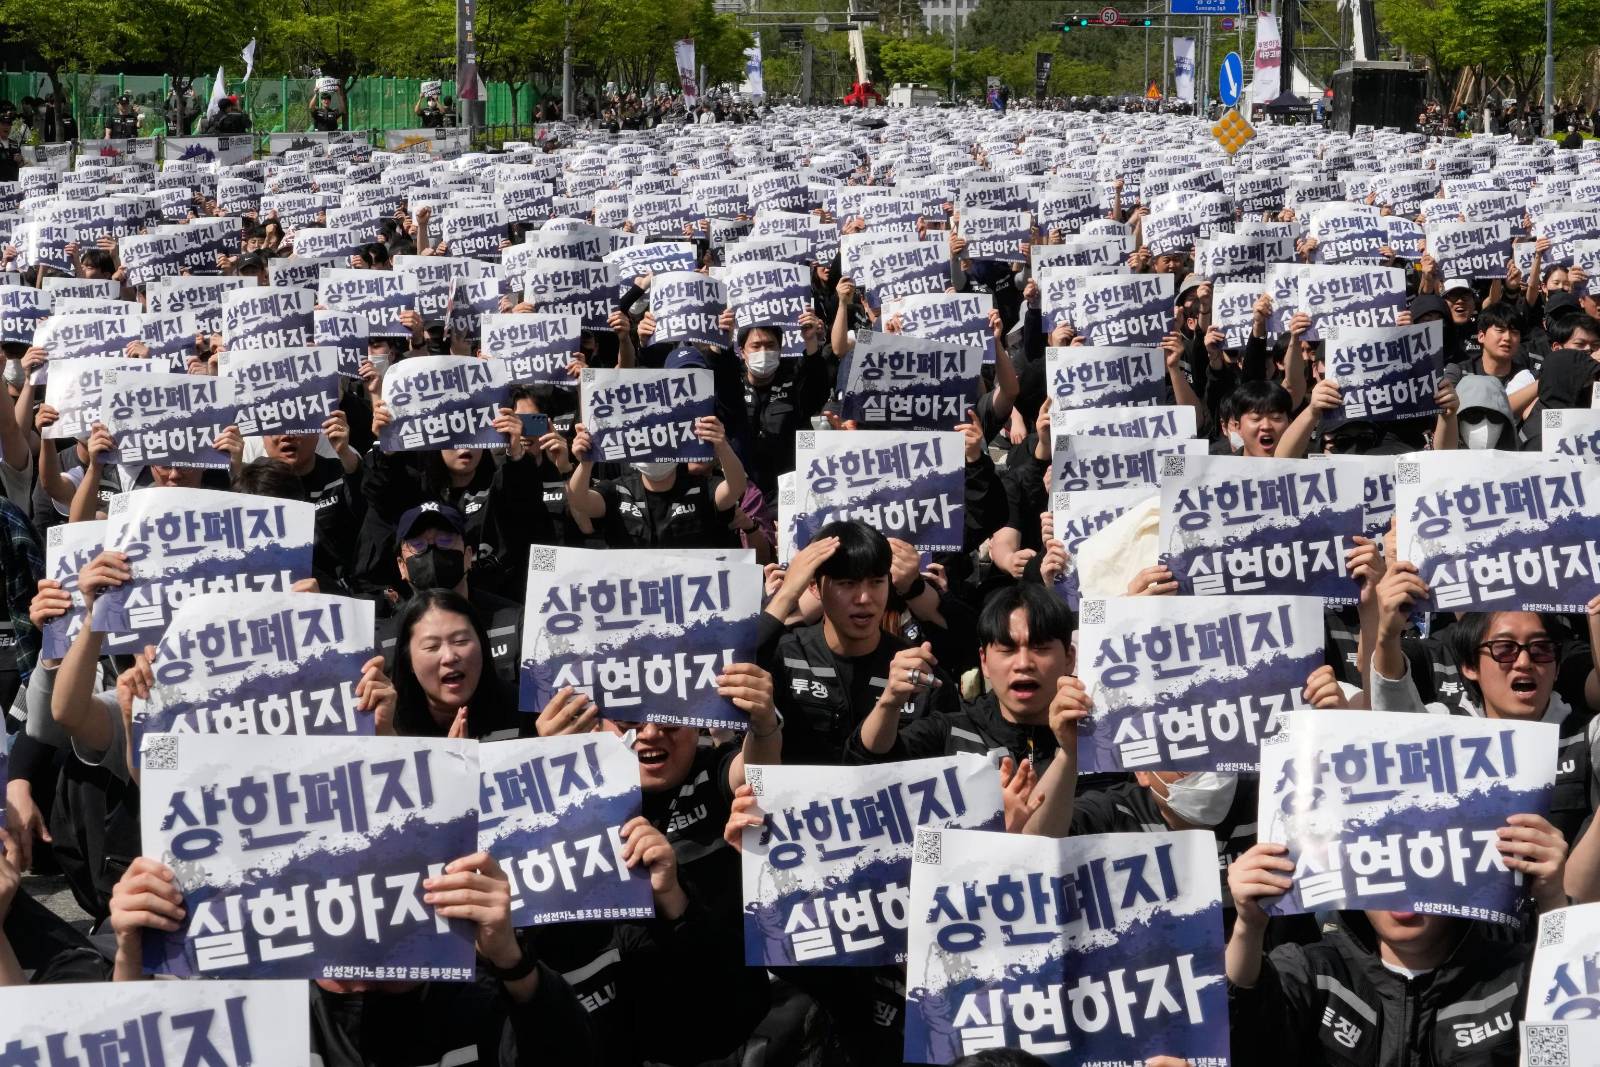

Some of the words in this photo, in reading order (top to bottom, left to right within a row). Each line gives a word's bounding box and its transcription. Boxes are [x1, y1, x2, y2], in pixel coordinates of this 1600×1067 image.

[1104, 11, 1115, 22] 50
[502, 186, 546, 204] 상한폐지
[965, 185, 1019, 207] 상한폐지
[1042, 194, 1091, 216] 상한폐지
[1466, 195, 1518, 216] 상한폐지
[713, 225, 753, 242] 상한폐
[964, 215, 1021, 235] 상한폐지
[1435, 225, 1500, 252] 상한폐지
[123, 237, 177, 264] 상한폐지
[870, 245, 939, 278] 상한폐지
[1212, 241, 1282, 266] 상한폐지
[1442, 251, 1511, 279] 실현하자
[326, 275, 403, 304] 상한폐지
[415, 262, 469, 285] 한폐지
[532, 267, 610, 294] 상한폐지
[728, 267, 800, 297] 상한폐지
[1306, 271, 1394, 306] 상한폐지
[226, 291, 300, 330] 상한폐지
[651, 279, 720, 310] 상한폐지
[735, 295, 805, 326] 실현하자
[1082, 277, 1161, 315] 상한폐지
[487, 317, 568, 351] 상한폐지
[1090, 311, 1175, 347] 실현하자
[860, 349, 966, 380] 상한폐지
[1332, 327, 1432, 376] 상한폐지
[389, 361, 492, 406] 상한폐지
[1054, 353, 1153, 397] 상한폐지
[110, 381, 217, 419] 상한폐지
[589, 373, 697, 418] 상한폐지
[862, 395, 976, 421] 실현하자
[1342, 370, 1440, 419] 실현하자
[234, 391, 339, 436] 실현하자
[399, 403, 500, 449] 실현하자
[118, 424, 228, 463] 실현하자
[600, 417, 704, 461] 실현하자
[806, 437, 944, 493] 상한폐지
[821, 493, 963, 534] 현하자
[1172, 467, 1338, 531] 상한폐지
[1411, 471, 1586, 538] 상한폐지
[114, 505, 287, 562] 상한폐지
[1186, 535, 1351, 596] 실현하자
[1428, 541, 1600, 609] 실현하자
[539, 570, 730, 634] 상한폐지
[153, 603, 345, 686] 상한폐지
[491, 644, 508, 657] LU
[1092, 604, 1294, 689] 상한폐지
[791, 677, 829, 699] 투쟁
[646, 713, 704, 728] 삼성전자노동조합
[479, 742, 605, 829] 폐지
[1273, 730, 1518, 813] 상한폐지
[161, 749, 432, 860] 상한폐지
[760, 767, 966, 870] 상한폐지
[499, 824, 629, 910] 하자
[533, 908, 602, 924] 삼성전자노동조합
[603, 907, 652, 918] 공동투쟁본부
[926, 843, 1180, 953] 상한폐지
[1413, 901, 1489, 920] 삼성전자노동조합
[188, 865, 449, 971] 실현하자
[322, 965, 407, 979] 삼성전자노동조합
[409, 967, 473, 980] 공동투쟁본부
[953, 954, 1225, 1056] 실현하자
[1455, 1011, 1514, 1048] SELU
